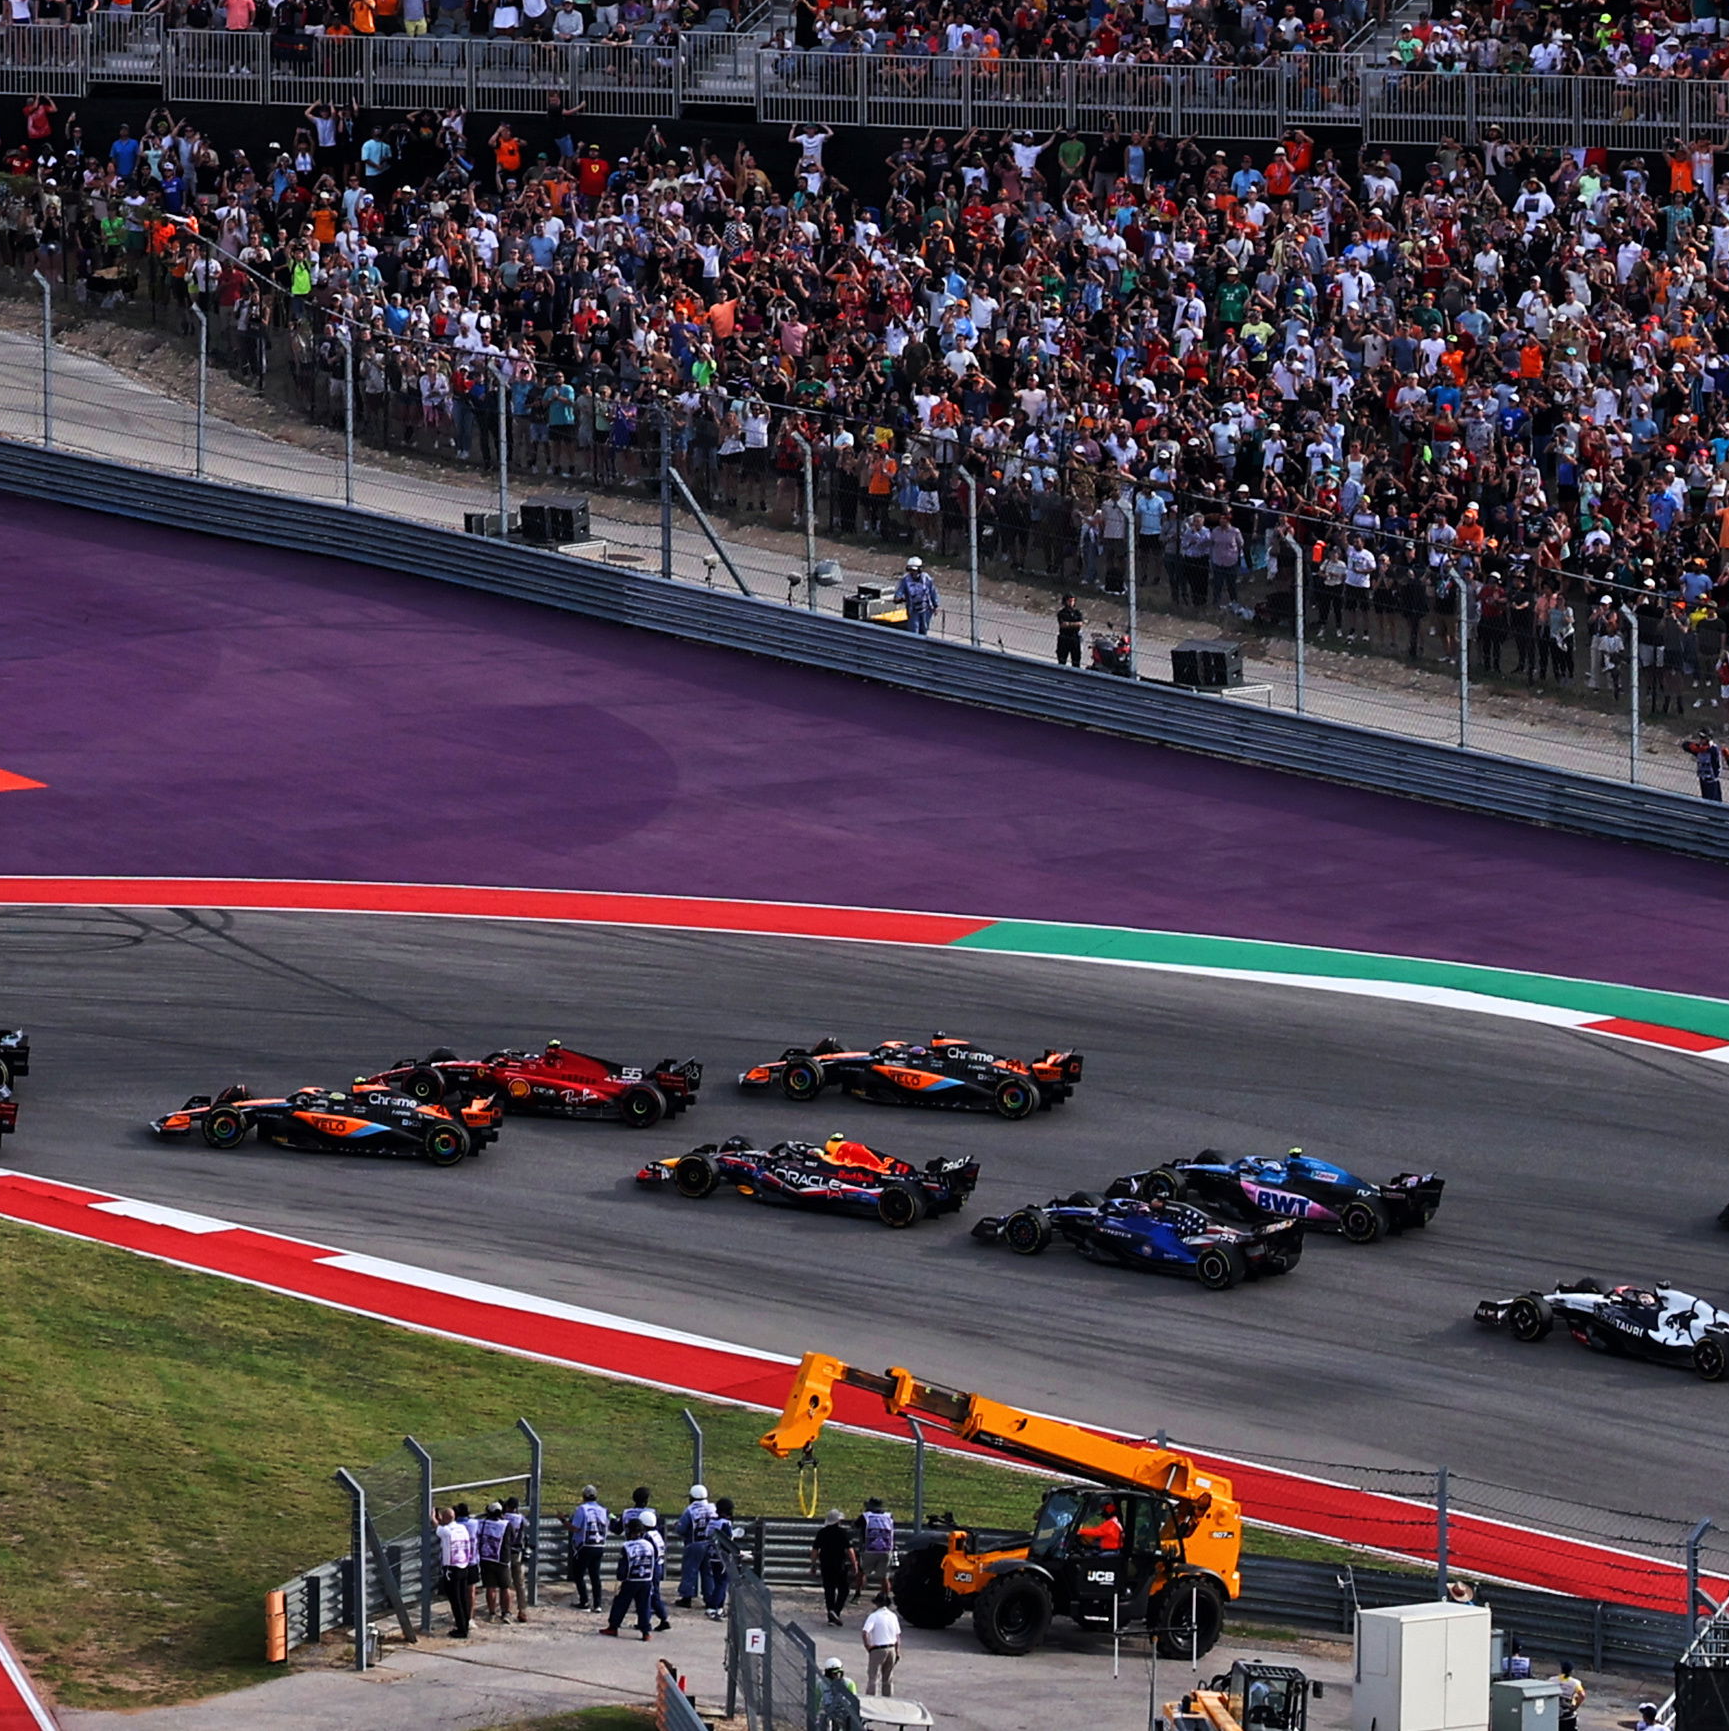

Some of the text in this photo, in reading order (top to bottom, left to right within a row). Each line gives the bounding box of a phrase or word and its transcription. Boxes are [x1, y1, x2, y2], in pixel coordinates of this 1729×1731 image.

[947, 1047, 995, 1062] Chrome
[621, 1066, 643, 1080] 55
[369, 1092, 417, 1108] Chrome
[775, 1168, 842, 1190] ORACLE
[1256, 1190, 1310, 1217] BWT
[954, 1572, 973, 1582] JCB
[1087, 1570, 1115, 1582] JCB
[751, 1635, 760, 1648] F
